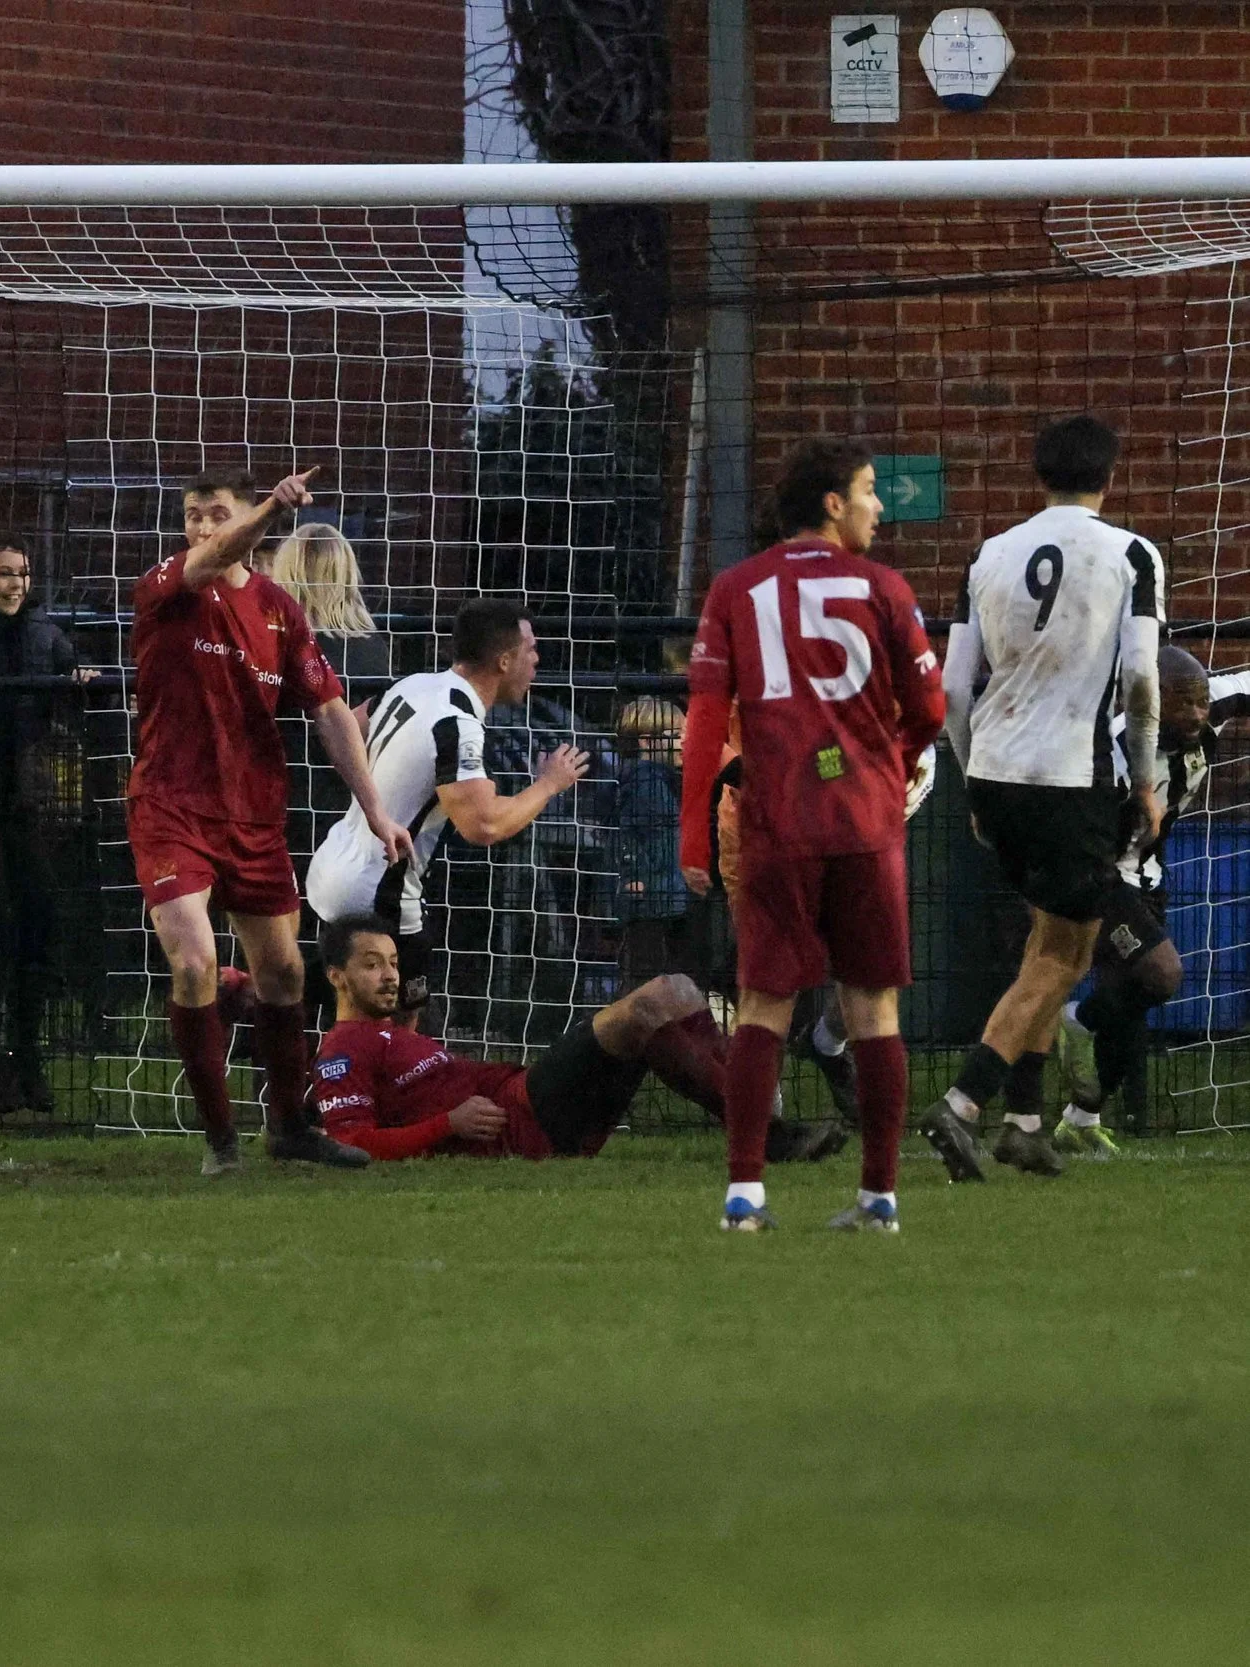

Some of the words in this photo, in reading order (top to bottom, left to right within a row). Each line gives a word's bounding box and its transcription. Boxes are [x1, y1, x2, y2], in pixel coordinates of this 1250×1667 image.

[847, 59, 882, 71] CCTV
[1025, 544, 1064, 632] 9
[748, 575, 872, 701] 15
[366, 694, 417, 772] 17
[324, 1065, 344, 1077] NHS
